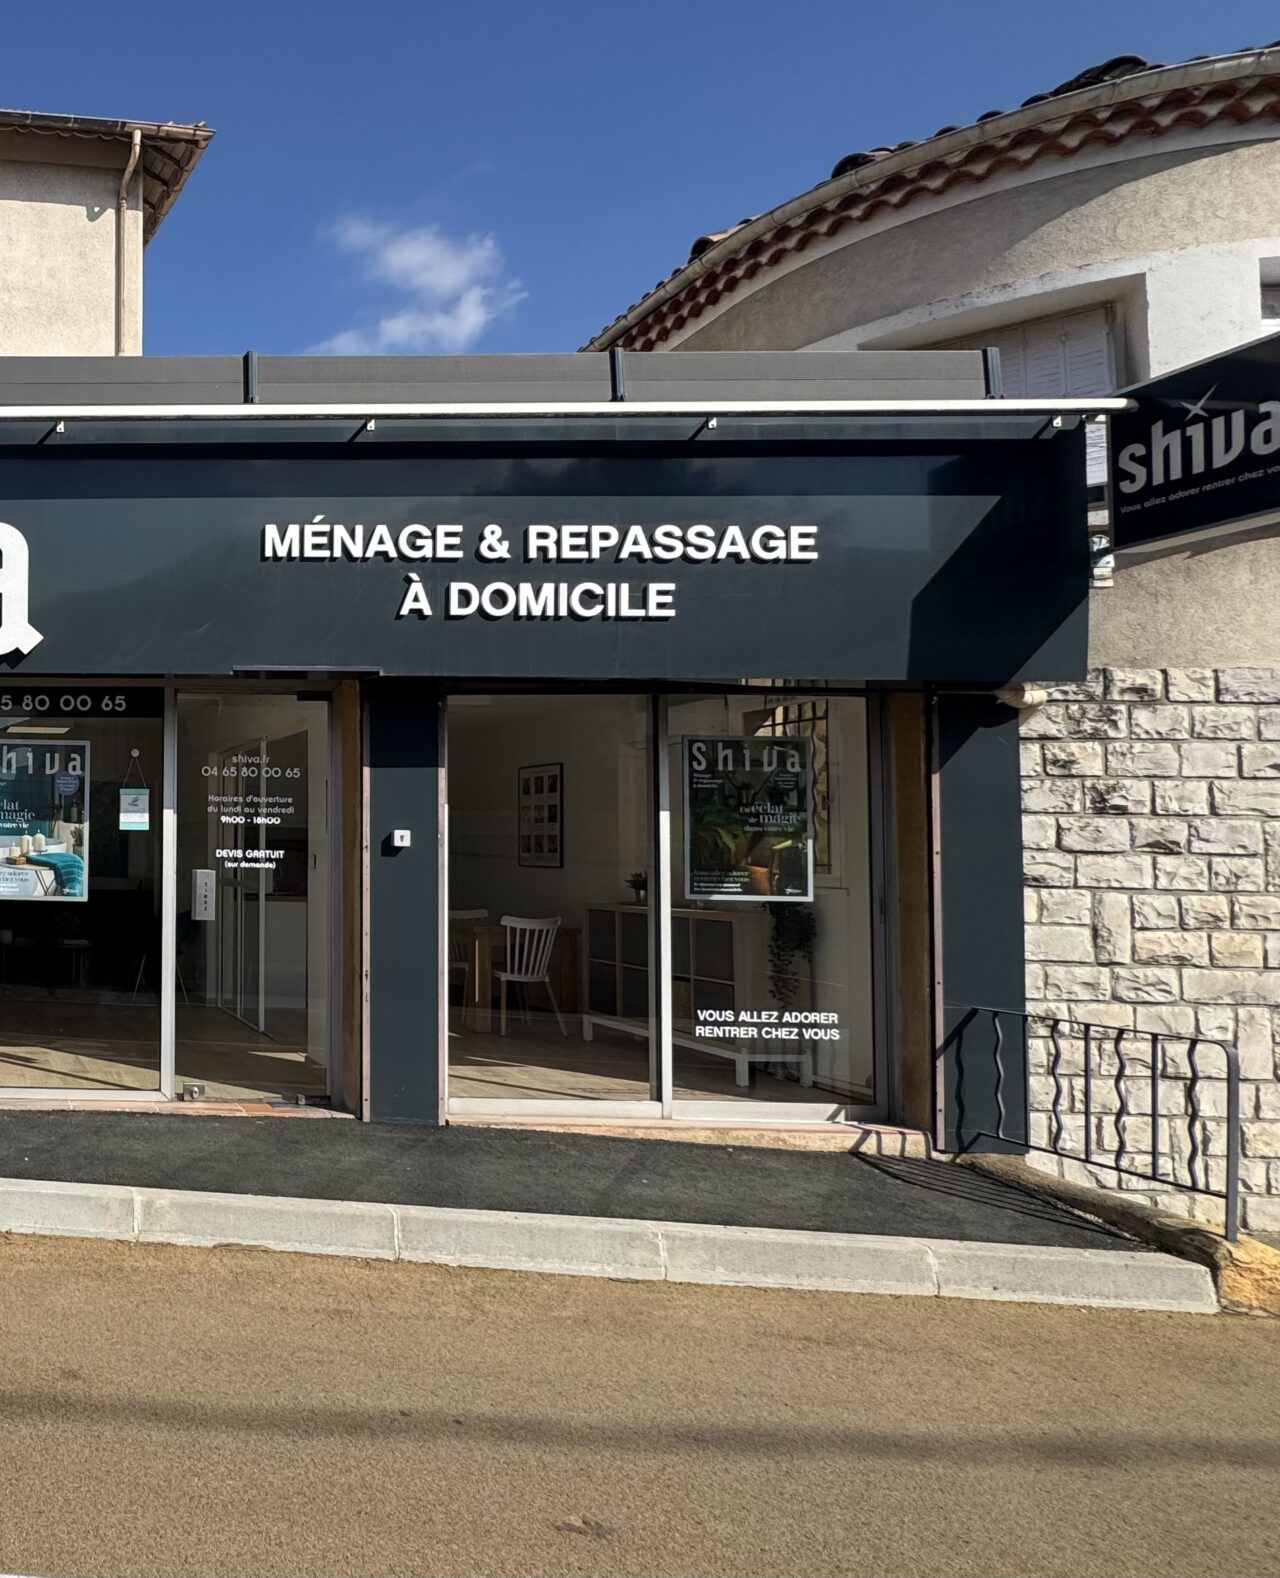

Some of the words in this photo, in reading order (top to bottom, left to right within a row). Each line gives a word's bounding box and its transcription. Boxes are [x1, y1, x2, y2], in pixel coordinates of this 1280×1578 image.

[1118, 384, 1280, 493] shiva
[1120, 503, 1142, 514] Vous
[1143, 495, 1167, 508] allez
[1168, 486, 1201, 502] adorer
[1202, 477, 1237, 492] rentrer
[1237, 468, 1265, 483] chez
[1267, 465, 1280, 474] vo
[262, 515, 464, 559] MÉNAGE
[480, 524, 511, 560] &
[527, 524, 819, 560] REPASSAGE
[398, 573, 433, 617] À
[449, 582, 677, 618] DOMICILE
[22, 694, 50, 711] 80
[59, 694, 92, 711] 00
[101, 695, 127, 712] 65
[231, 753, 271, 764] shiva.fr
[691, 741, 802, 773] Shiva
[201, 766, 218, 777] 04
[222, 766, 237, 777] 65
[241, 766, 258, 777] 80
[262, 767, 281, 778] 00
[285, 767, 300, 778] 65
[208, 794, 243, 803] Horaires
[246, 795, 293, 803] d'ouverture
[207, 804, 218, 813] du
[220, 804, 241, 813] lundi
[244, 806, 255, 814] au
[257, 805, 295, 814] vendredi
[220, 815, 245, 824] 9h00
[215, 848, 244, 858] DEVIS
[245, 849, 285, 859] GRATUIT
[224, 860, 239, 869] (sur
[240, 860, 276, 869] demande)
[696, 1009, 735, 1022] VOUS
[738, 1010, 779, 1023] ALLEZ
[782, 1011, 839, 1024] ADORER
[695, 1025, 758, 1039] RENTRER
[761, 1027, 799, 1040] CHEZ
[802, 1027, 840, 1040] VOUS
